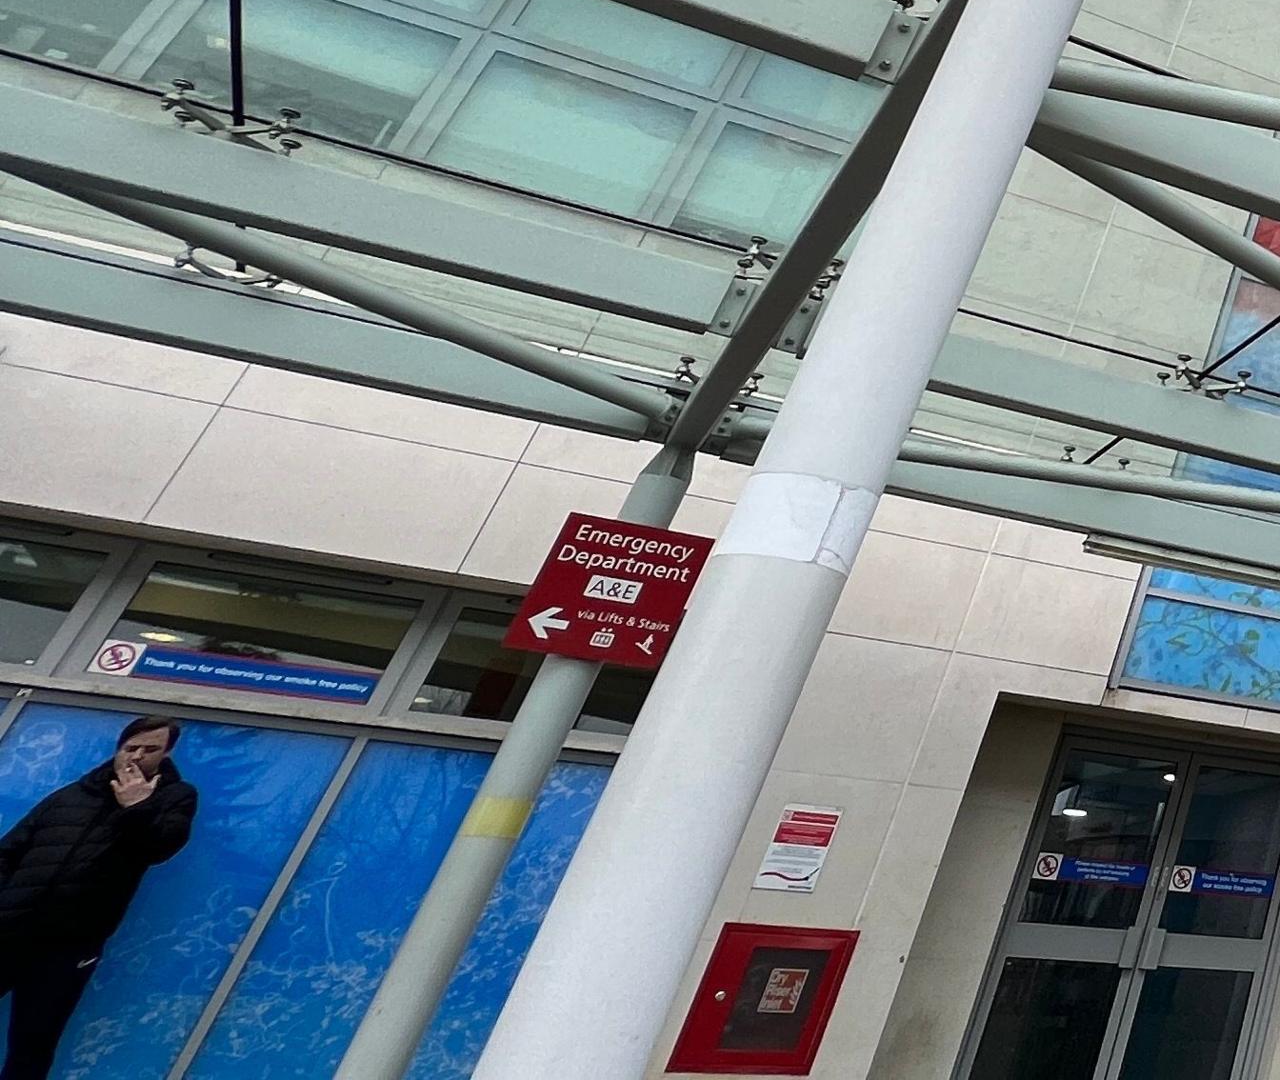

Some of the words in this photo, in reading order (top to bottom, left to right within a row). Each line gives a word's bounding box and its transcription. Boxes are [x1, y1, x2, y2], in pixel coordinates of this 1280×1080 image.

[575, 524, 694, 562] Emergency
[557, 544, 690, 582] Department
[588, 580, 636, 600] A&E
[577, 609, 596, 620] via
[597, 611, 624, 625] Lifts
[625, 616, 636, 627] &
[637, 618, 671, 633] Stairs
